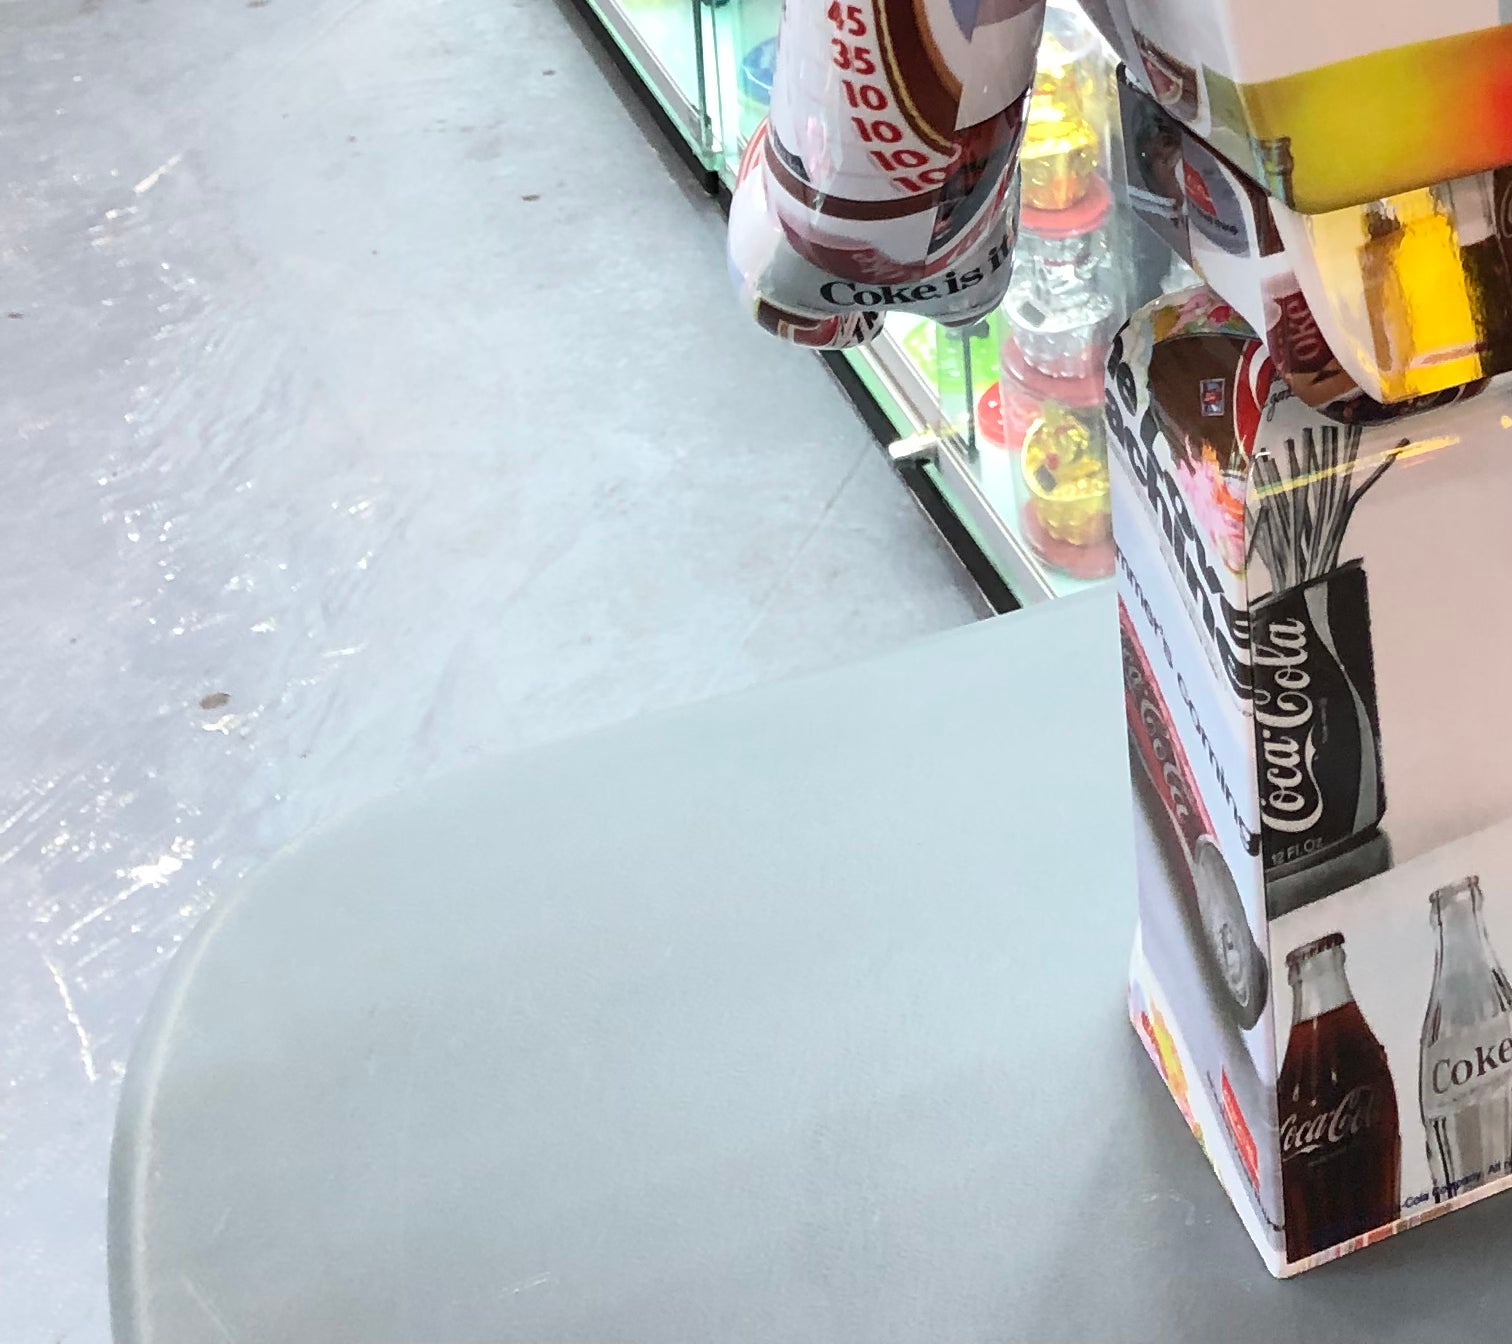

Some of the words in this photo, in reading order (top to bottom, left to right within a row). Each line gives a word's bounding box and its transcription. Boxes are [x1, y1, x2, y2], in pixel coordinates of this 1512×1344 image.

[827, 0, 868, 38] 45
[831, 37, 873, 77] 35
[841, 80, 888, 113] 10
[851, 116, 904, 144] 10
[870, 149, 931, 175] 10
[819, 276, 943, 312] Coke
[943, 256, 985, 299] is
[1253, 617, 1325, 834] Coca-Cola
